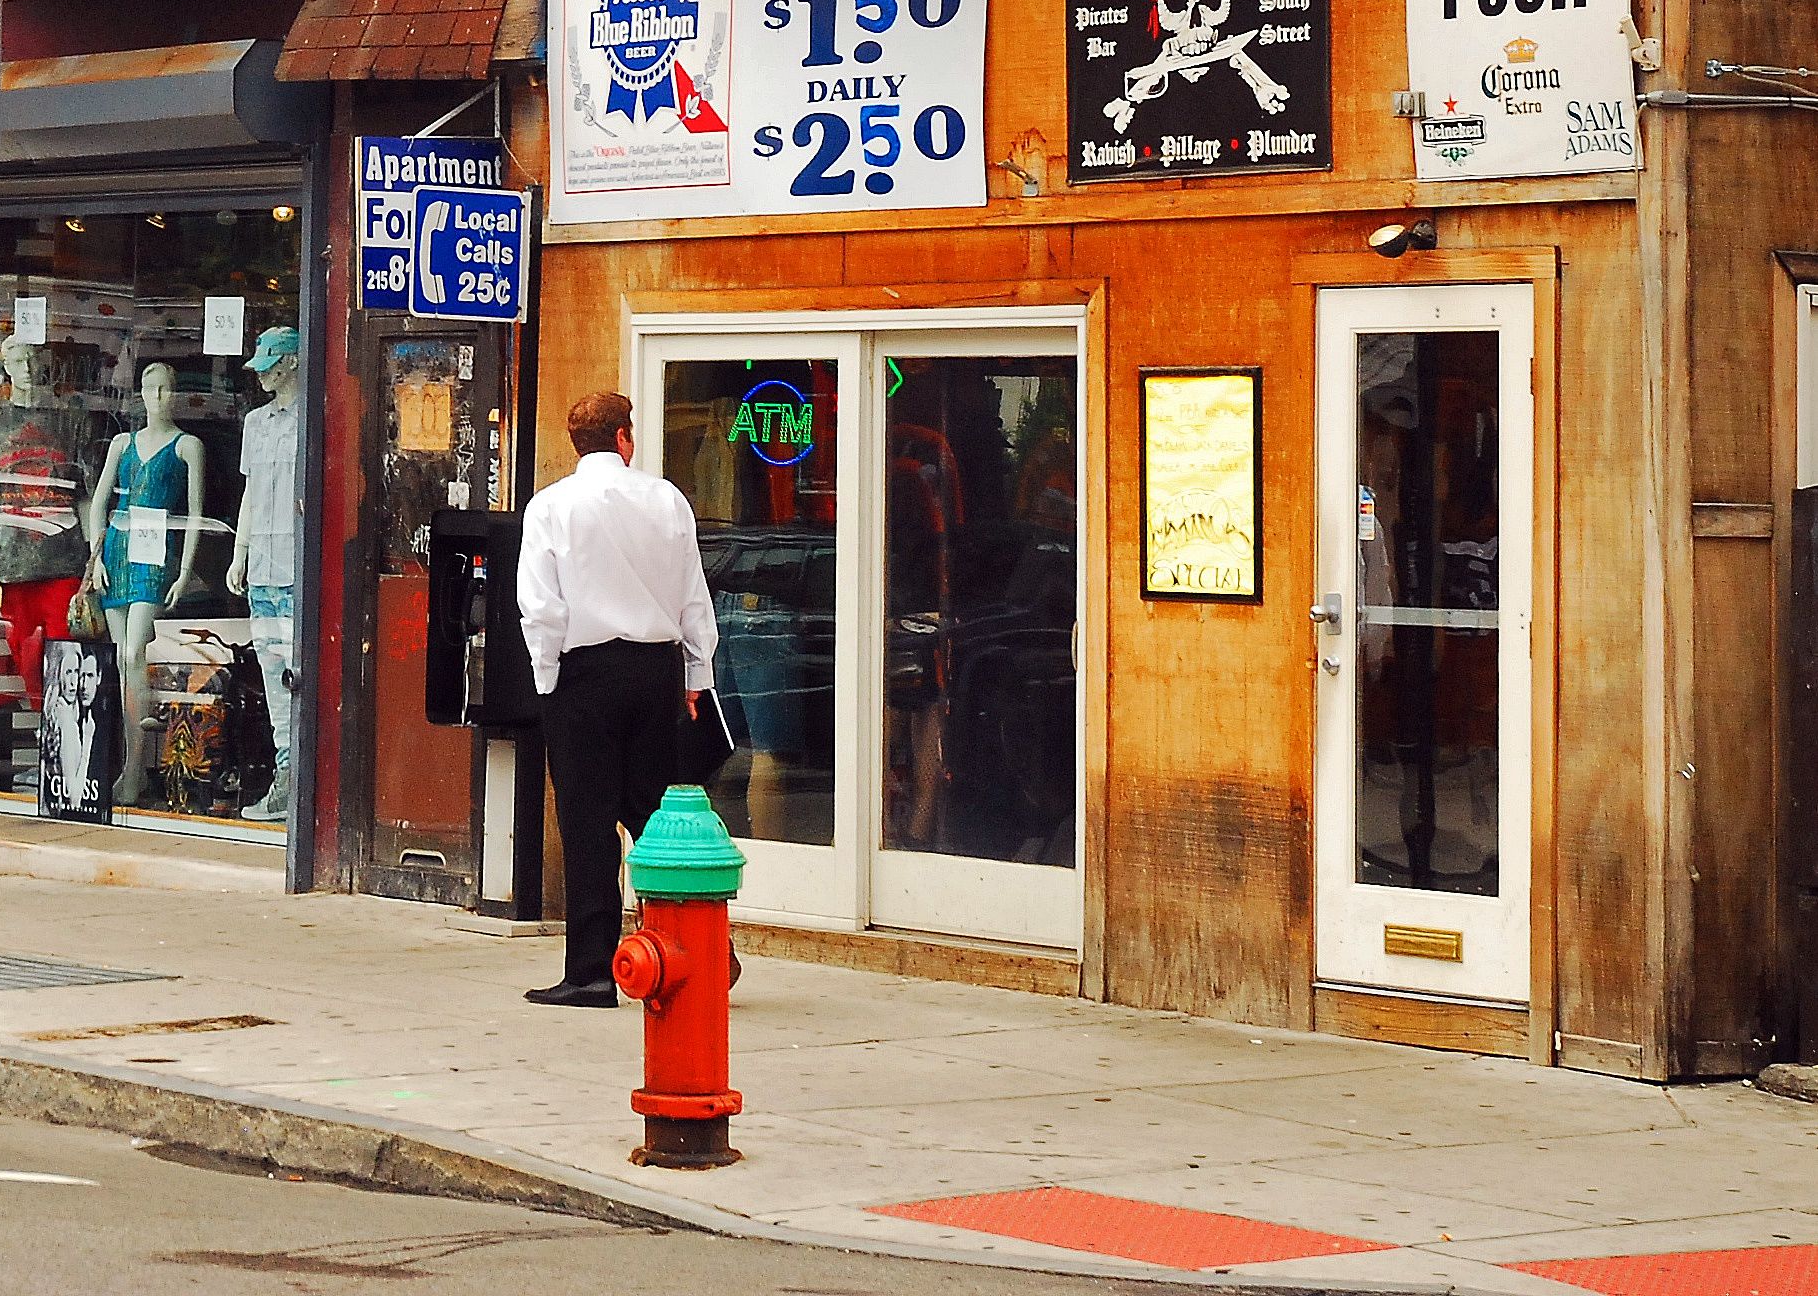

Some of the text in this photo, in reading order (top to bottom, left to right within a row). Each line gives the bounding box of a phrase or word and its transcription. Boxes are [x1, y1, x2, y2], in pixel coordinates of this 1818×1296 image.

[592, 5, 695, 46] Blue Ribbon
[1075, 6, 1128, 30] Pirates
[1259, 23, 1311, 45] Street
[625, 46, 656, 58] BEER
[1087, 38, 1117, 60] Bar
[807, 74, 908, 104] DAILY
[1482, 63, 1561, 103] Corona
[1506, 97, 1543, 116] Extra
[1567, 101, 1626, 134] SAM
[1425, 121, 1482, 141] Heineken
[1081, 129, 1317, 167] Ravish Pillage Plunder
[1564, 133, 1633, 161] ADAMS
[366, 146, 502, 190] Apartment
[455, 205, 517, 233] Local
[455, 237, 514, 265] Calls
[457, 271, 511, 306] 25¢
[727, 402, 813, 444] ATM
[50, 775, 99, 801] GUSS
